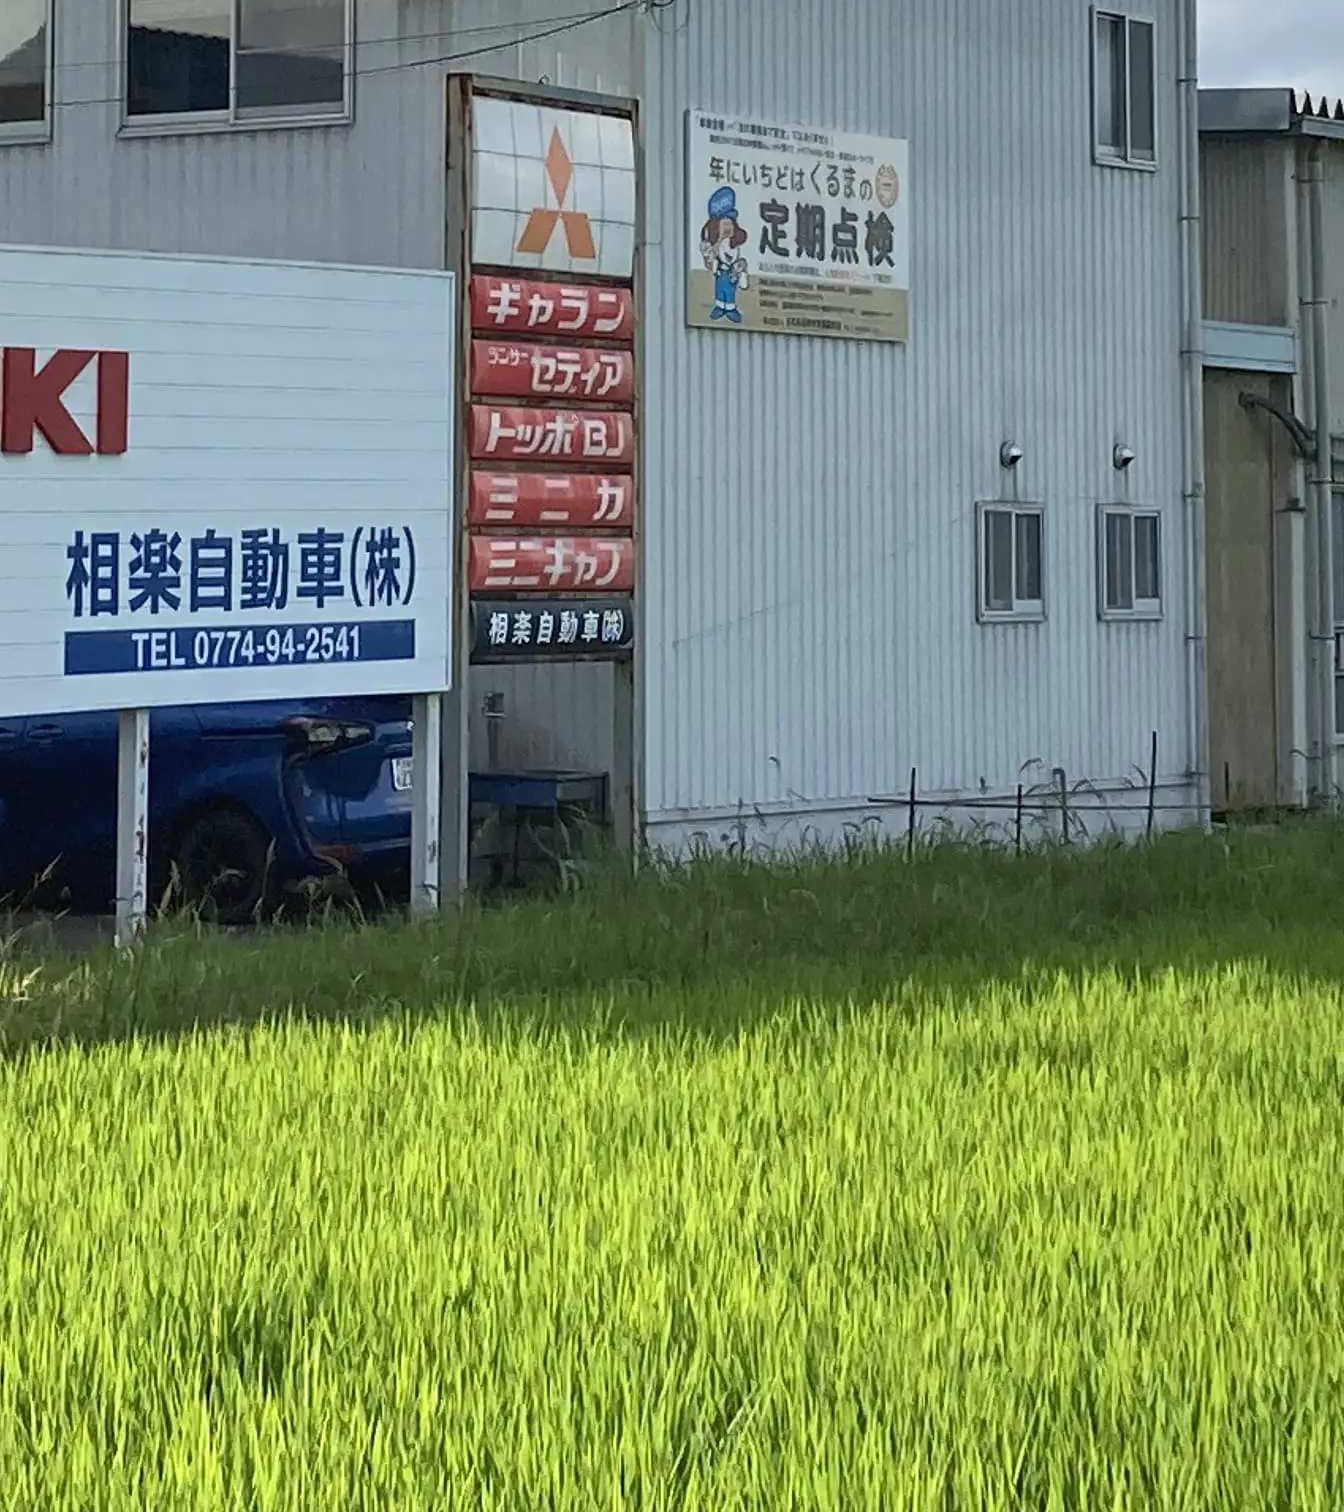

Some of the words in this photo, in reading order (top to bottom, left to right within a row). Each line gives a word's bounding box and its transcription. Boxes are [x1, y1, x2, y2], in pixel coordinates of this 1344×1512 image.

[708, 155, 874, 202] 年にいちどはくるまの
[759, 197, 896, 268] 定期点検
[487, 282, 625, 333] ギャラン
[485, 477, 625, 521] ミニカ
[66, 525, 416, 618] 相楽自動車(株)
[131, 631, 186, 670] TEL
[193, 624, 361, 666] 0774-94-2541
